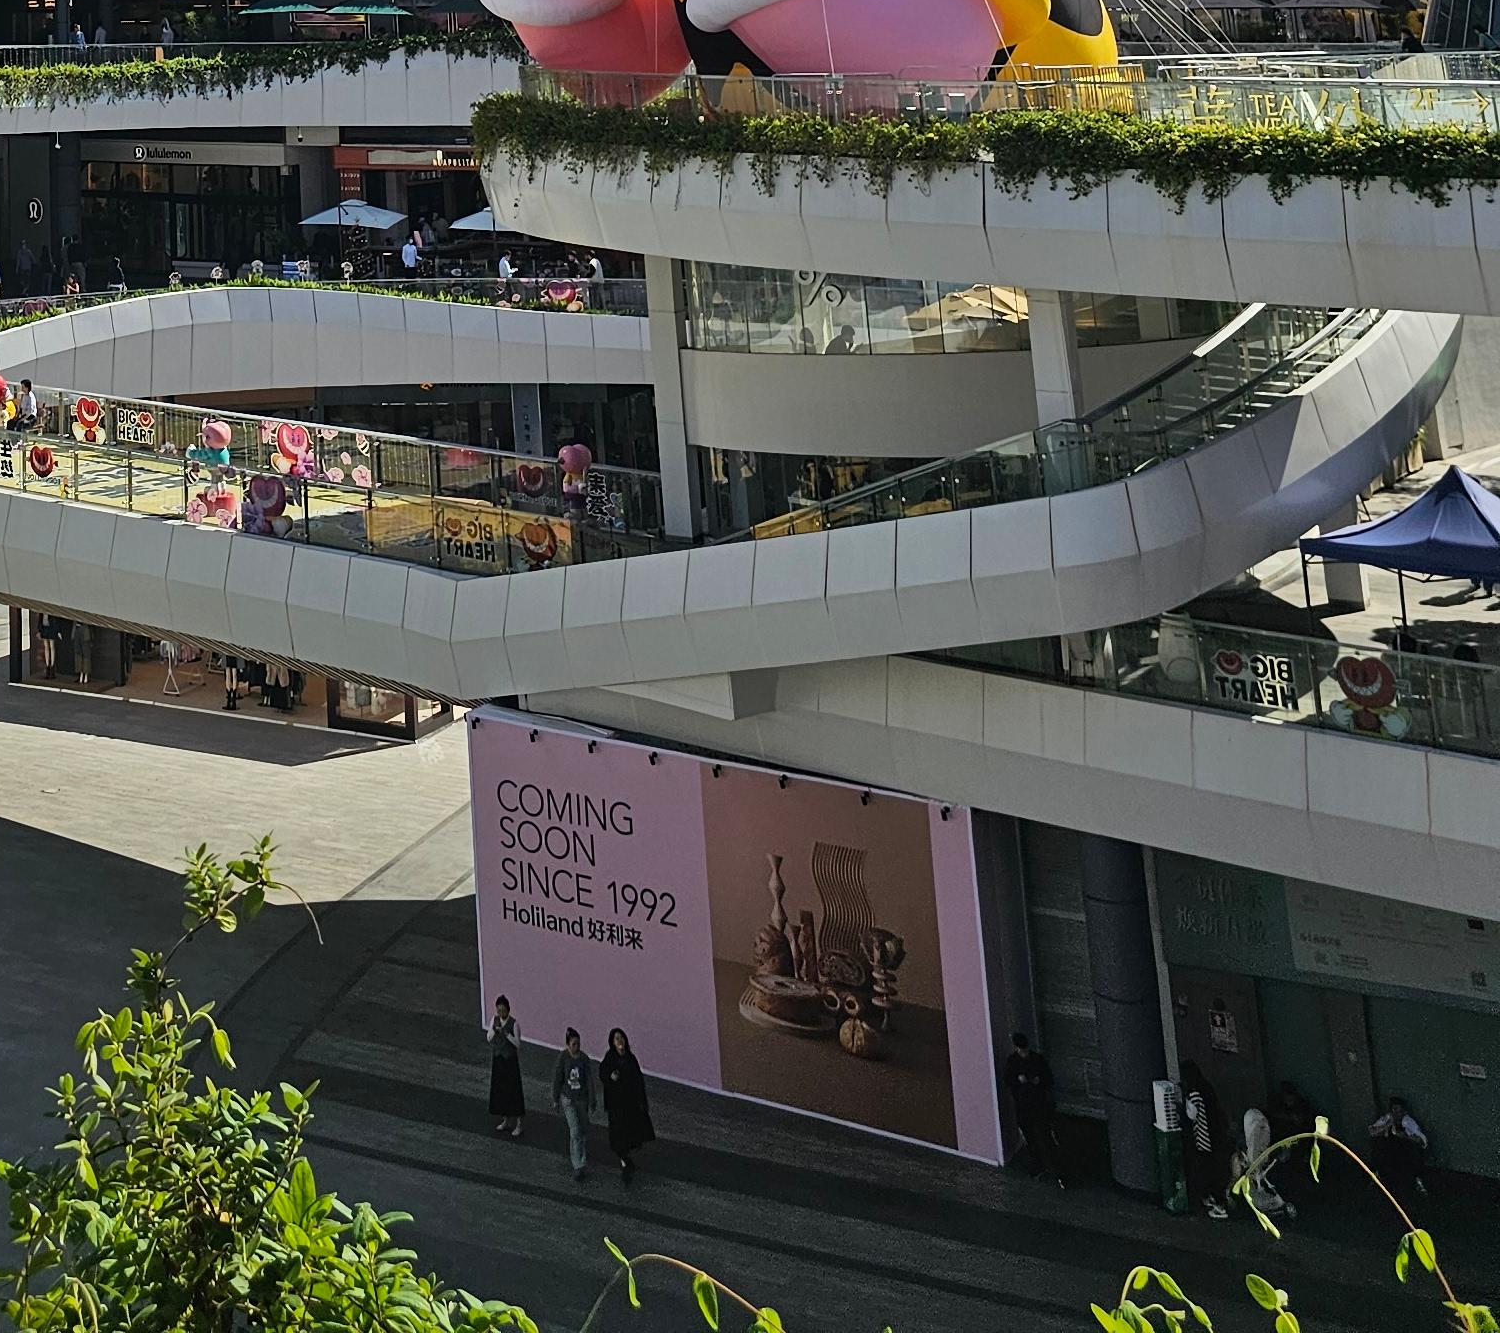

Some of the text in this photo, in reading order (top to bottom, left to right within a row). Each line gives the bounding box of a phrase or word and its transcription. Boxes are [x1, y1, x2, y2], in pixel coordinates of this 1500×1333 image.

[1249, 94, 1298, 117] TEA
[1411, 87, 1440, 110] 2F
[147, 147, 192, 159] lululemon
[118, 409, 137, 424] BIG
[118, 426, 154, 444] HEART
[497, 779, 634, 836] COMING
[500, 816, 595, 867] SOON
[501, 857, 678, 928] SINCE 1992
[502, 898, 643, 950] Holiland 好利来
